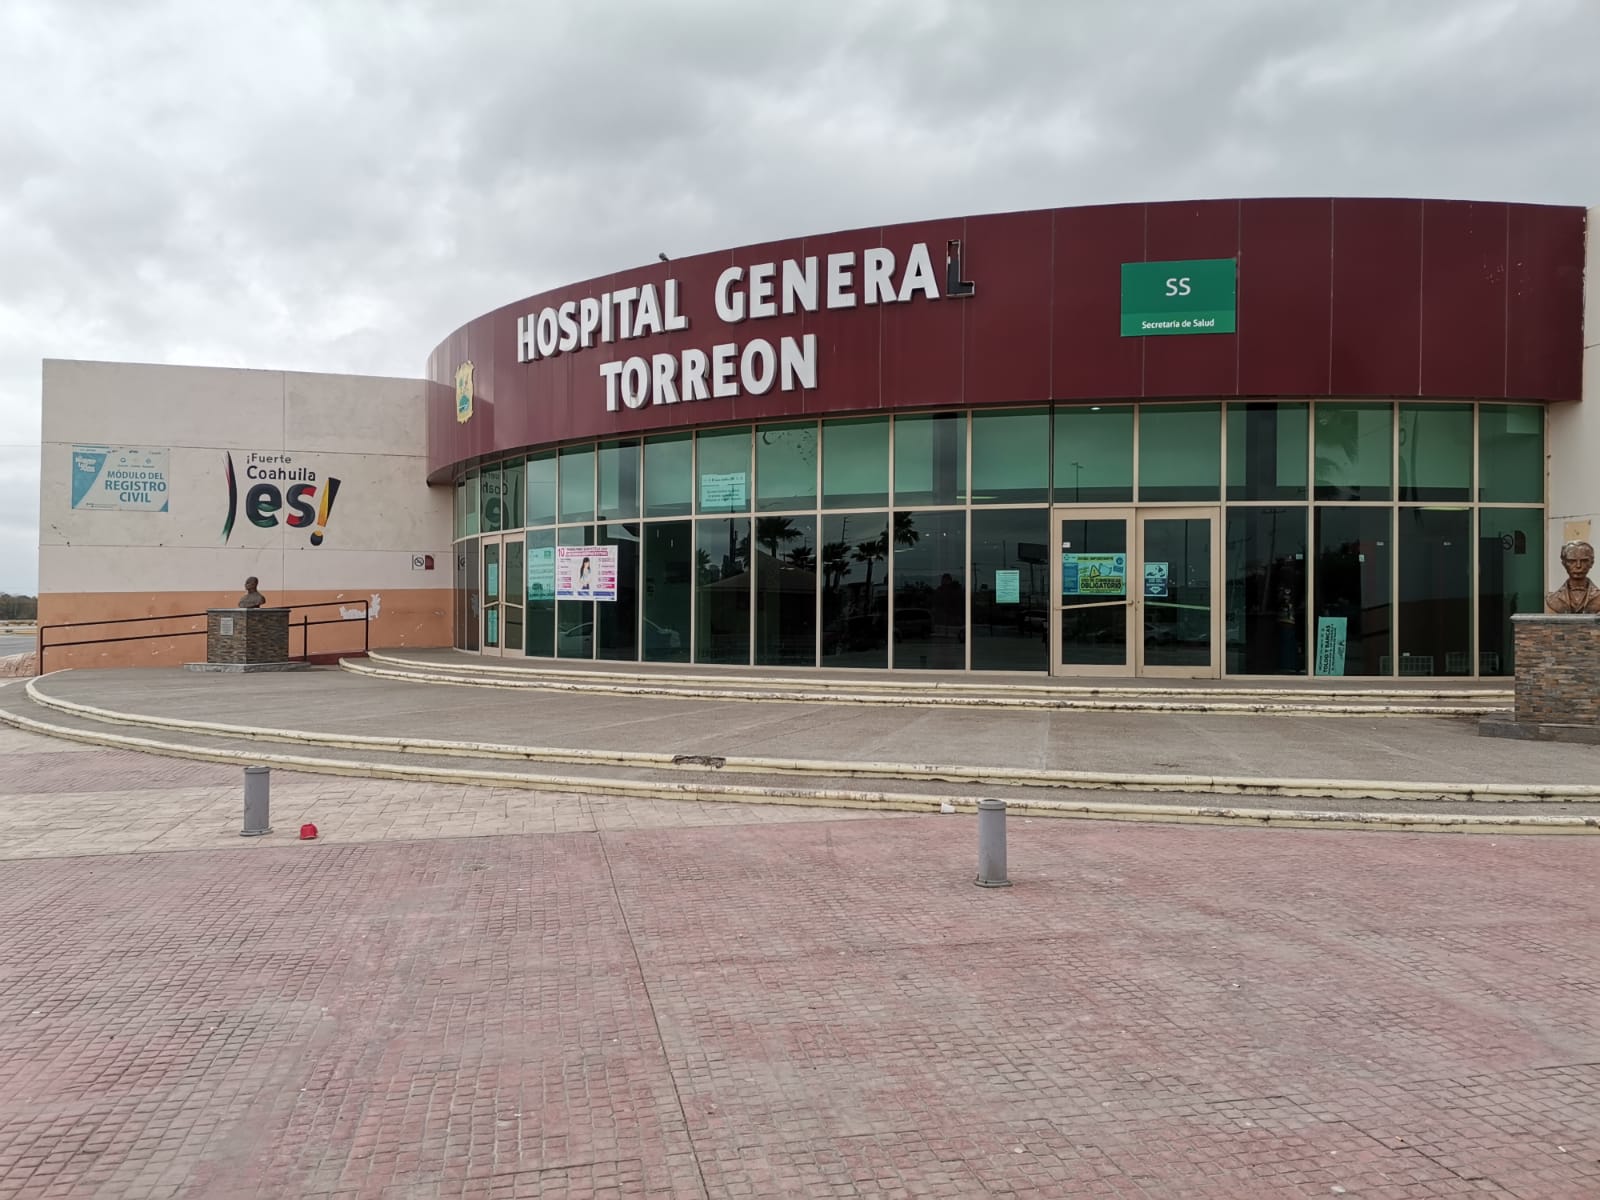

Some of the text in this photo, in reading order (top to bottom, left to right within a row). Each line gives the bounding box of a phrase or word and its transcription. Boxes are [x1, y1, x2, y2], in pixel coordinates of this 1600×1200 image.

[1165, 277, 1192, 297] SS
[517, 239, 975, 364] HOSPITAL GENERAL
[1181, 319, 1192, 328] de
[1193, 318, 1215, 327] Salud
[599, 333, 818, 413] TORREON
[107, 469, 164, 480] MÓDULO DEL
[246, 465, 316, 481] Coahuila
[105, 480, 167, 492] REGISTRO
[119, 492, 151, 503] CIVIL
